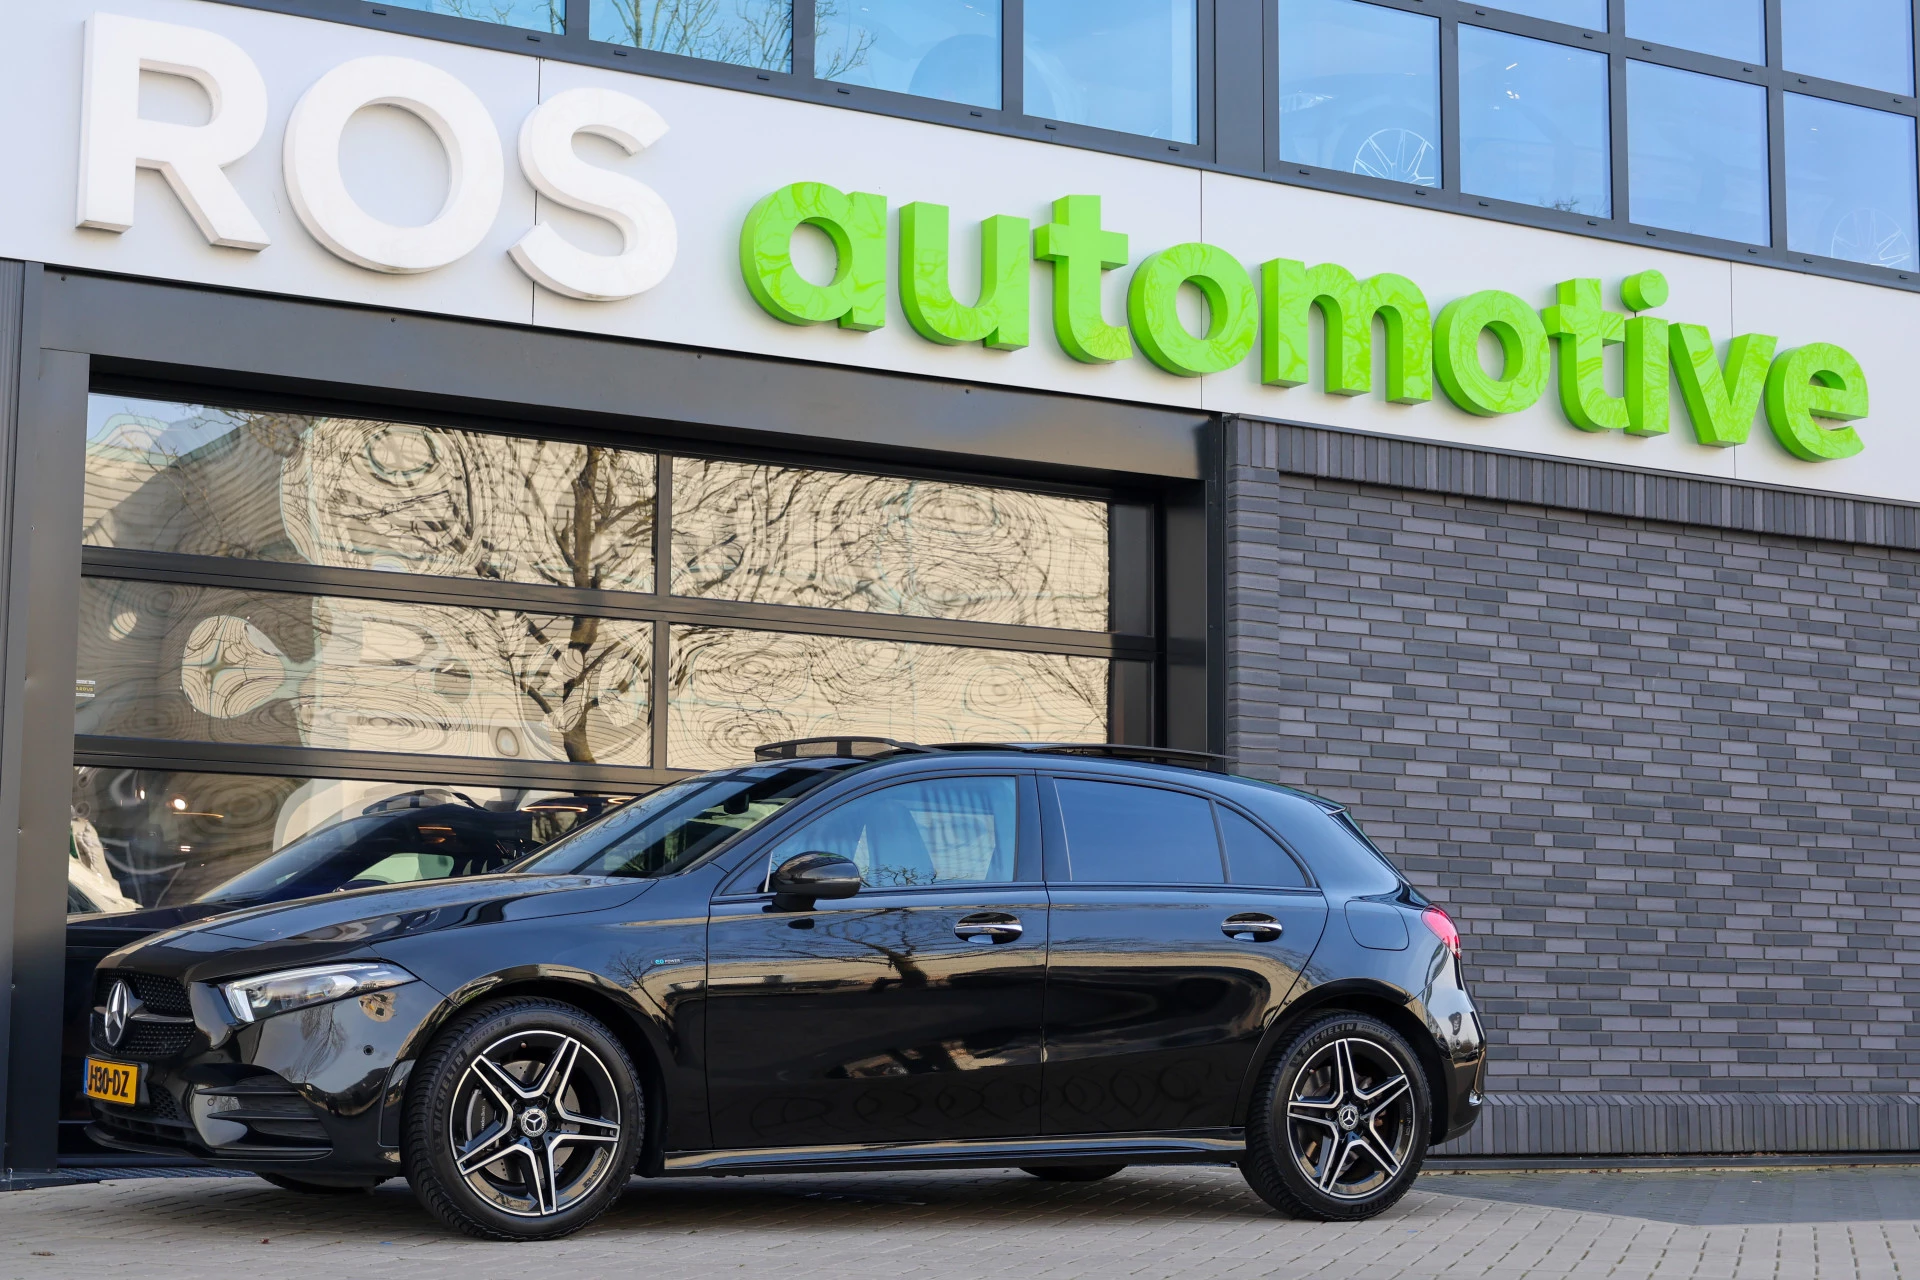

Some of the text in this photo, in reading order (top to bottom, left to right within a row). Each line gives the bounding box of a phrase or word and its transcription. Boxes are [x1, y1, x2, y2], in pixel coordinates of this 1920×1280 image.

[75, 10, 1869, 463] ROS automotive
[1301, 1023, 1354, 1053] MICHELIN
[433, 1051, 465, 1130] MICHELIN
